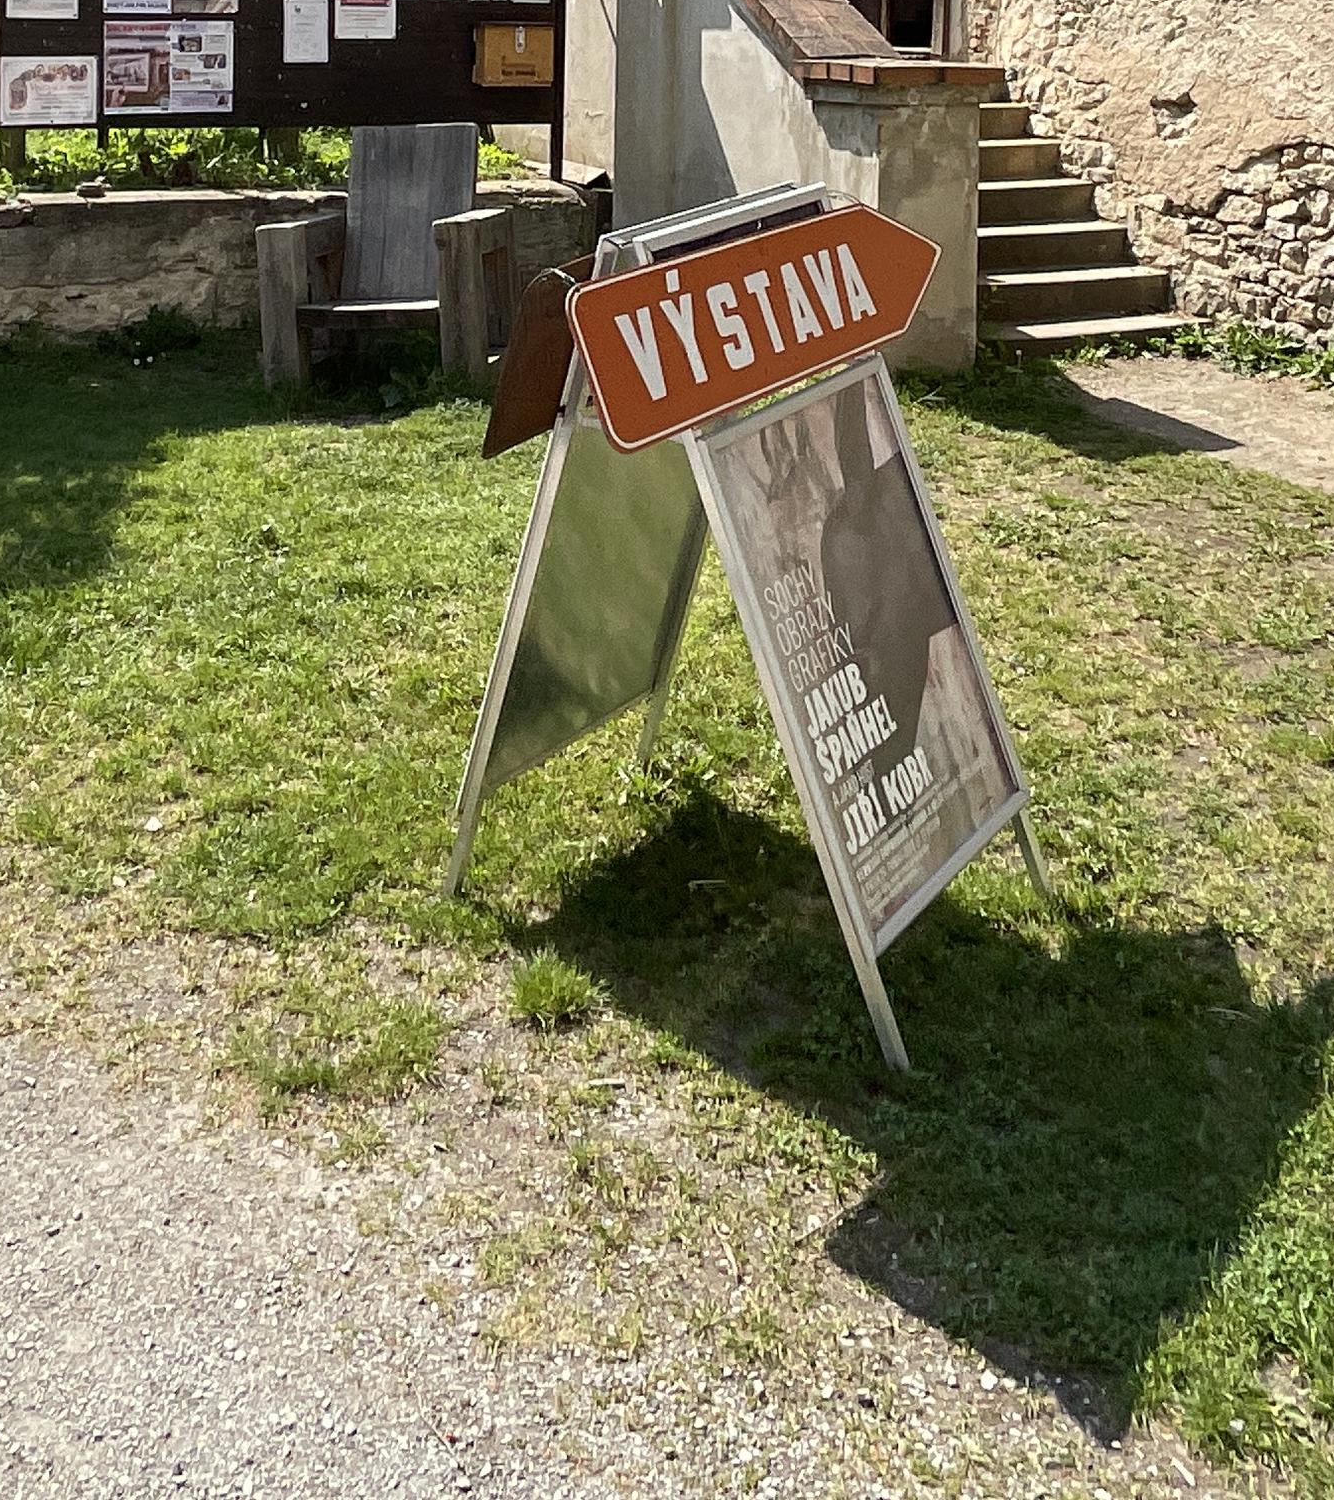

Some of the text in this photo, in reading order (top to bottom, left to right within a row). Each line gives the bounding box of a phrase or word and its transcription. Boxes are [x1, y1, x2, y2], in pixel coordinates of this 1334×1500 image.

[614, 243, 877, 401] VÝSTAVA
[763, 560, 817, 621] SOCHY
[776, 591, 836, 656] OBRAZY
[788, 622, 855, 693] GRAFIKY
[804, 663, 867, 740] JAKUB
[814, 694, 898, 784] ŠPAŇHEL
[842, 746, 934, 855] JIŘÍ KOBR
